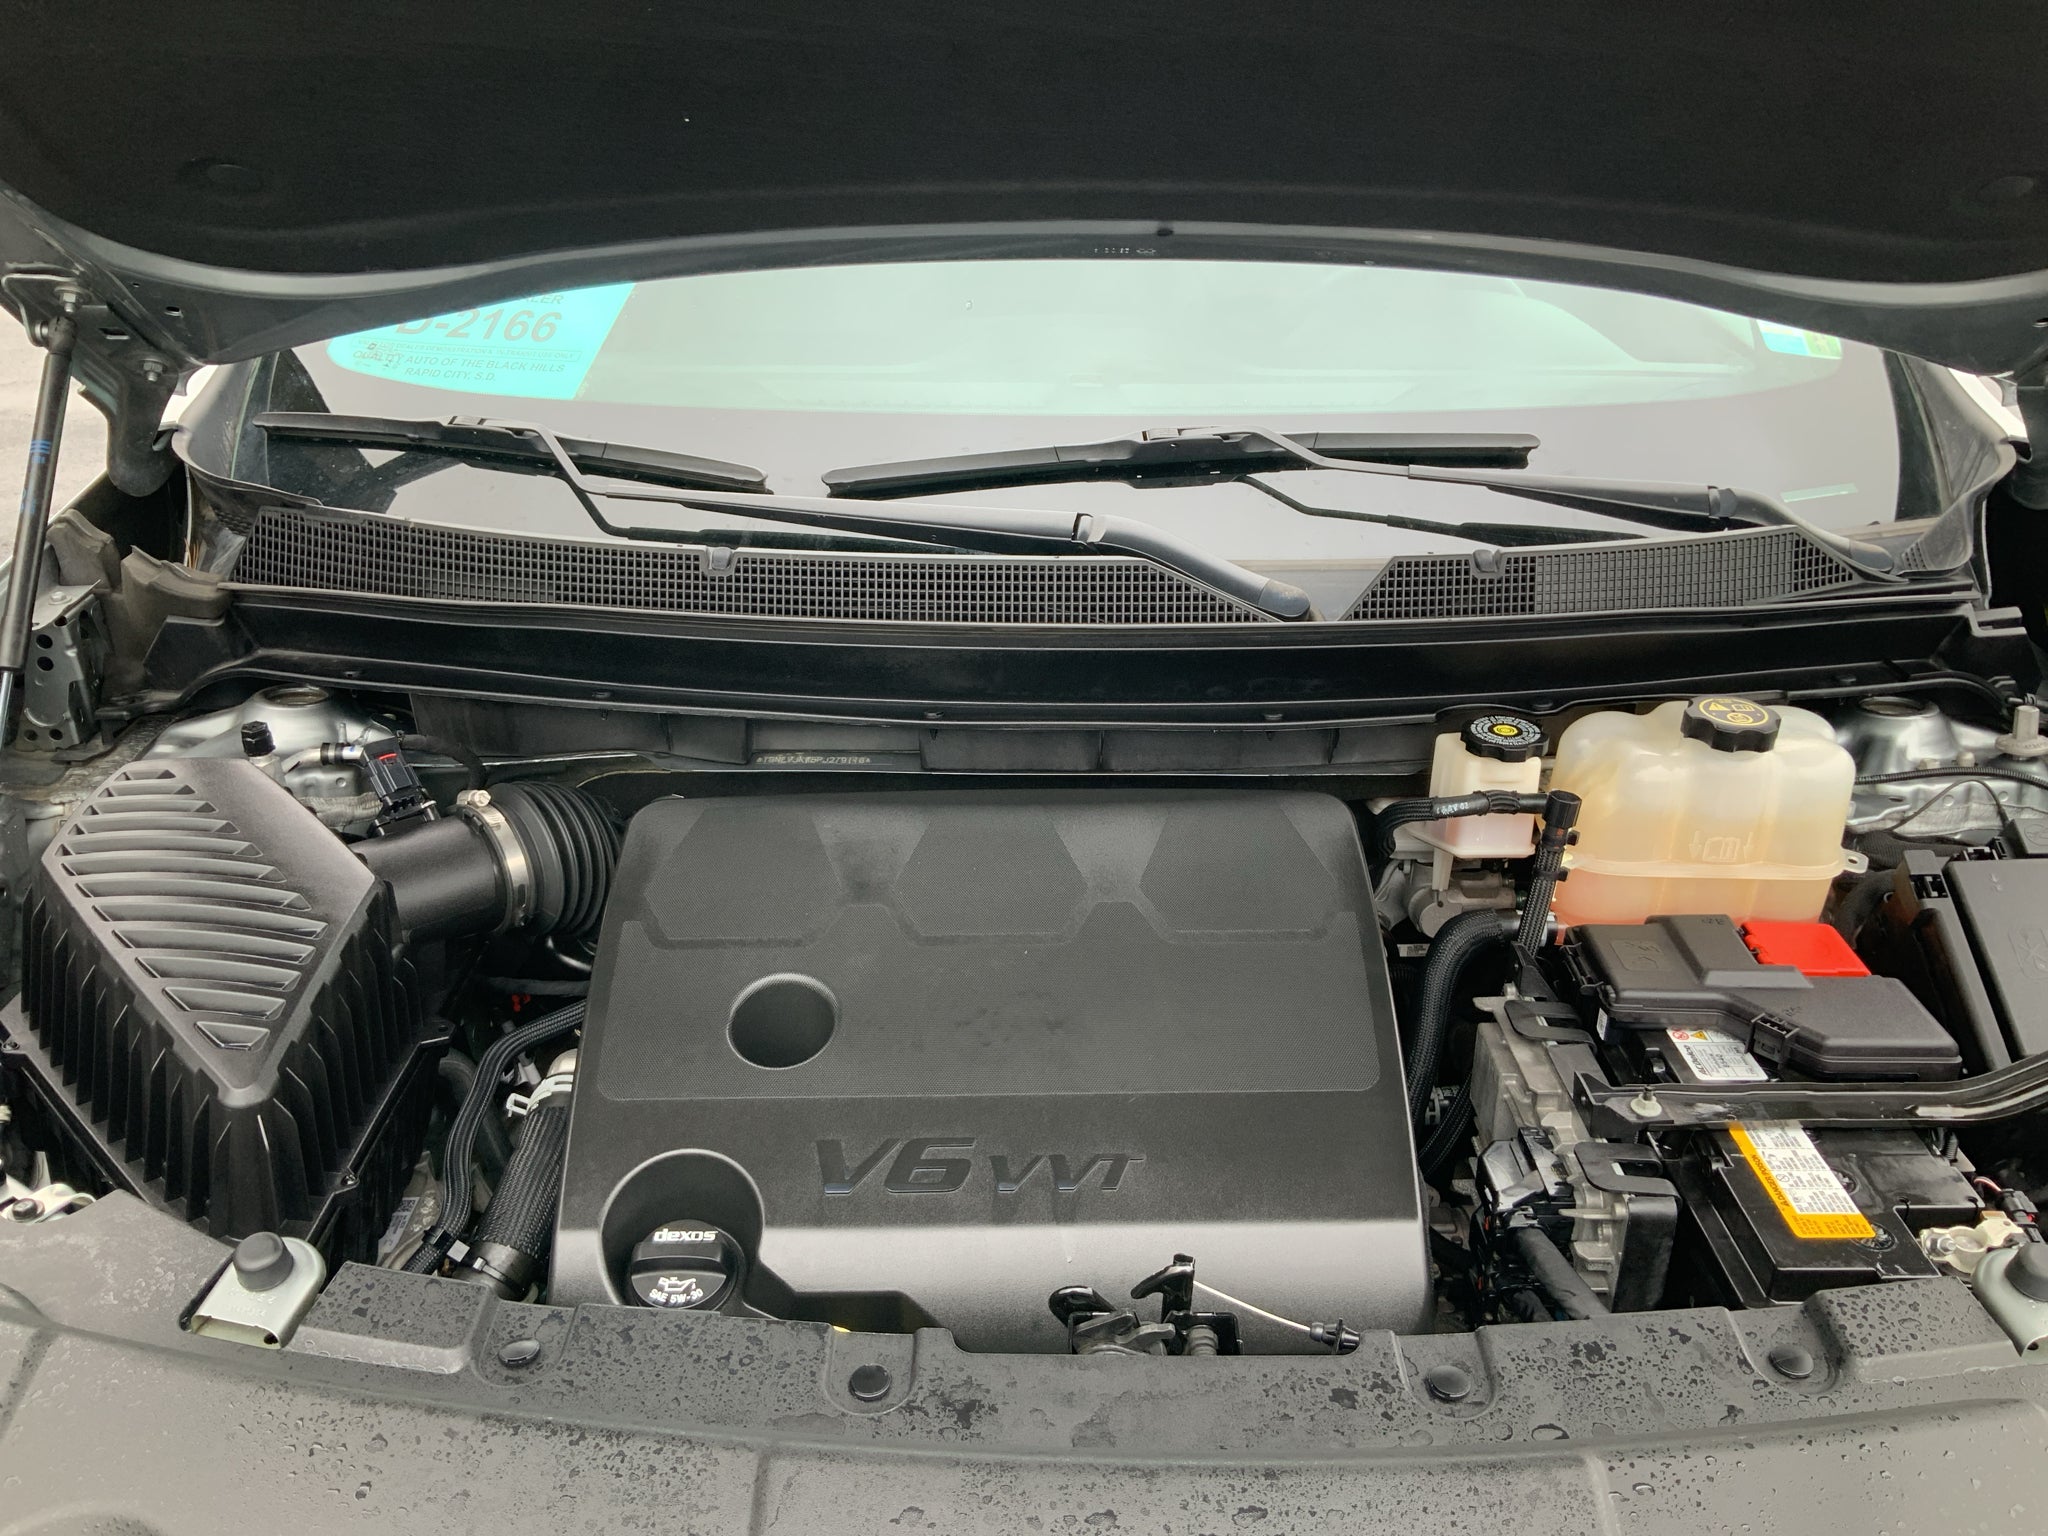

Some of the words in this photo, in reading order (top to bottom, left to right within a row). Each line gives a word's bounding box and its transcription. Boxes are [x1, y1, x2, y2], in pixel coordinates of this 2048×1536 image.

[405, 355, 439, 366] AUTO
[440, 357, 458, 367] OF
[461, 359, 485, 369] THE
[486, 360, 528, 371] BLACK
[529, 362, 566, 373] HILLS
[404, 367, 441, 378] RAPID
[815, 1137, 976, 1196] V6
[988, 1154, 1147, 1192] VVT
[653, 1228, 718, 1242] dexos
[649, 1288, 669, 1303] SAE
[670, 1288, 704, 1304] 5W-30
